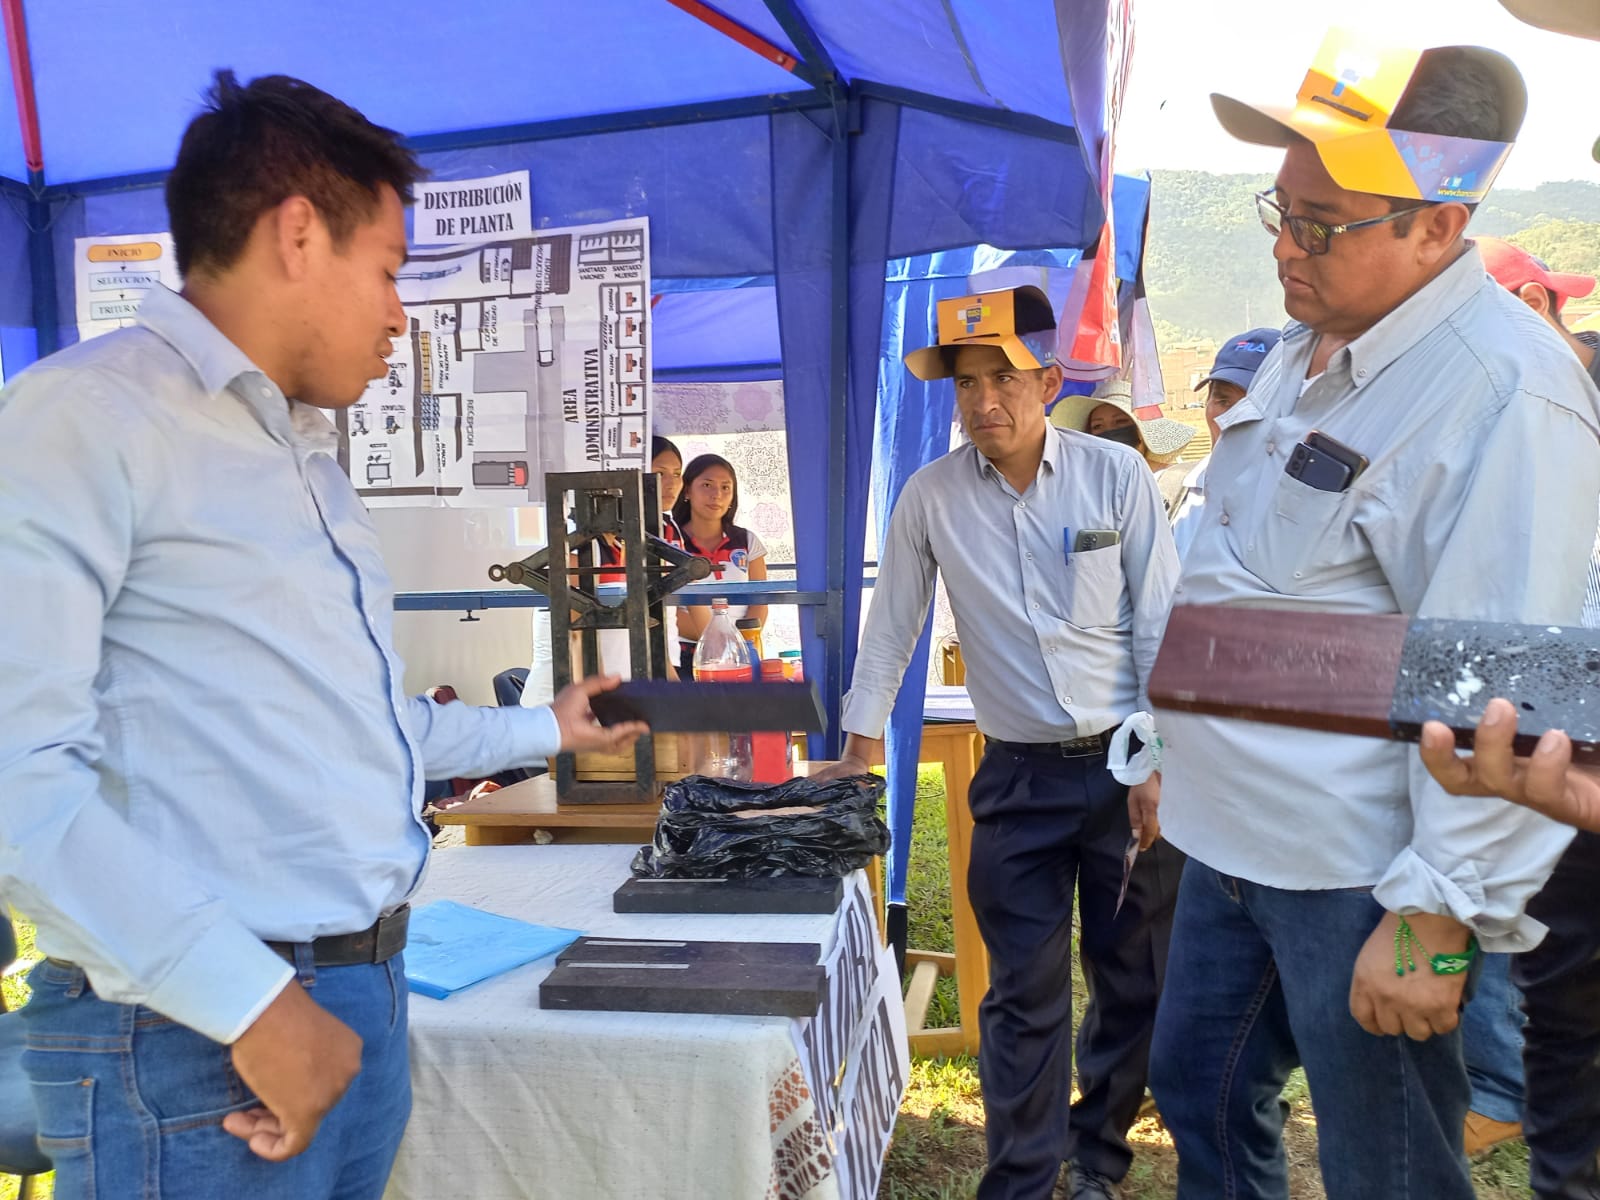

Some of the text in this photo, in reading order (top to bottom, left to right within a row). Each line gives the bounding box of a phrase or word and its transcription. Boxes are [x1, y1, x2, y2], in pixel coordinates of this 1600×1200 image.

[423, 180, 522, 210] DISTRIBUCIÓN
[435, 212, 514, 236] DE PLANTA
[106, 247, 142, 258] INICIO
[1235, 340, 1266, 353] FILA
[563, 389, 578, 423] AREA
[584, 348, 600, 463] ADMINISTRATIVA
